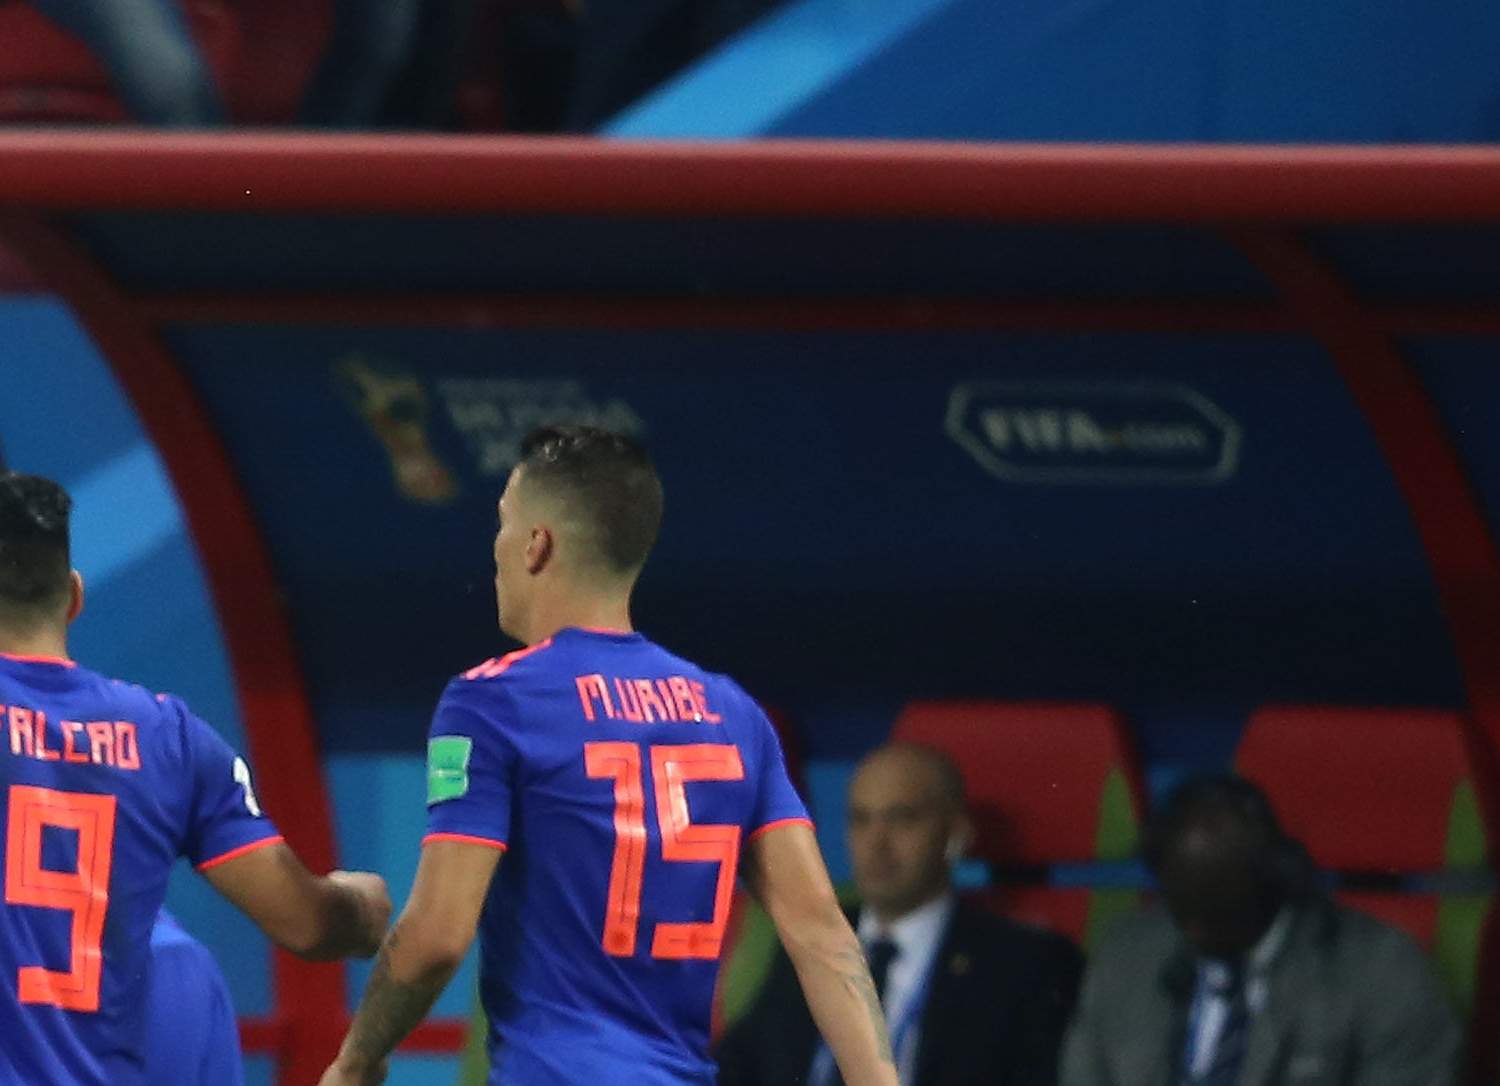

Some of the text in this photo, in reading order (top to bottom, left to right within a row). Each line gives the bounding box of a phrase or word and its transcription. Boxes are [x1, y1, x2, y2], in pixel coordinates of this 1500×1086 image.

[575, 673, 722, 724] M.URIBE
[4, 783, 118, 1013] 9
[584, 741, 745, 960] 15
